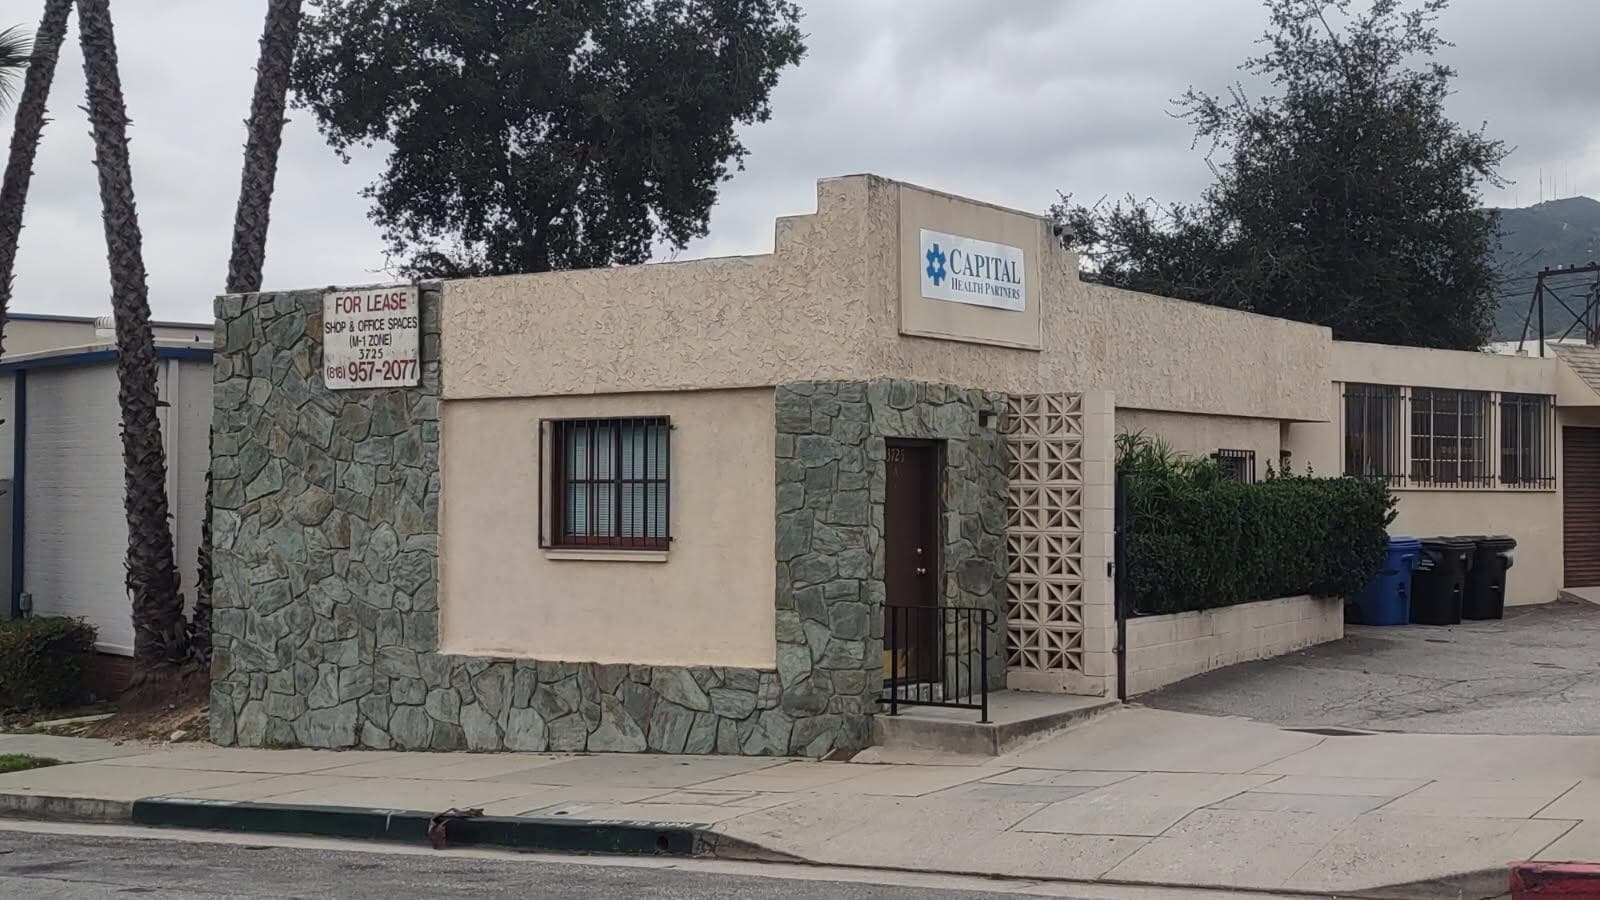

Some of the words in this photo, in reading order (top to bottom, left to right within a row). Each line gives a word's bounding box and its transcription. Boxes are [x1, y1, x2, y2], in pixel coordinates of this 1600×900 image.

[950, 248, 1021, 284] CAPITAL
[951, 277, 983, 294] HEALTH
[985, 282, 1020, 300] PARTNERS
[335, 296, 361, 314] FOR
[367, 292, 407, 312] LEASE
[325, 321, 346, 334] SHOP
[349, 321, 355, 332] &
[358, 318, 385, 332] OFFICE
[388, 316, 417, 330] SPACES
[349, 334, 366, 348] (M-1
[368, 332, 392, 346] ZONE)
[358, 348, 383, 360] 3725
[348, 359, 417, 382] 957-2077
